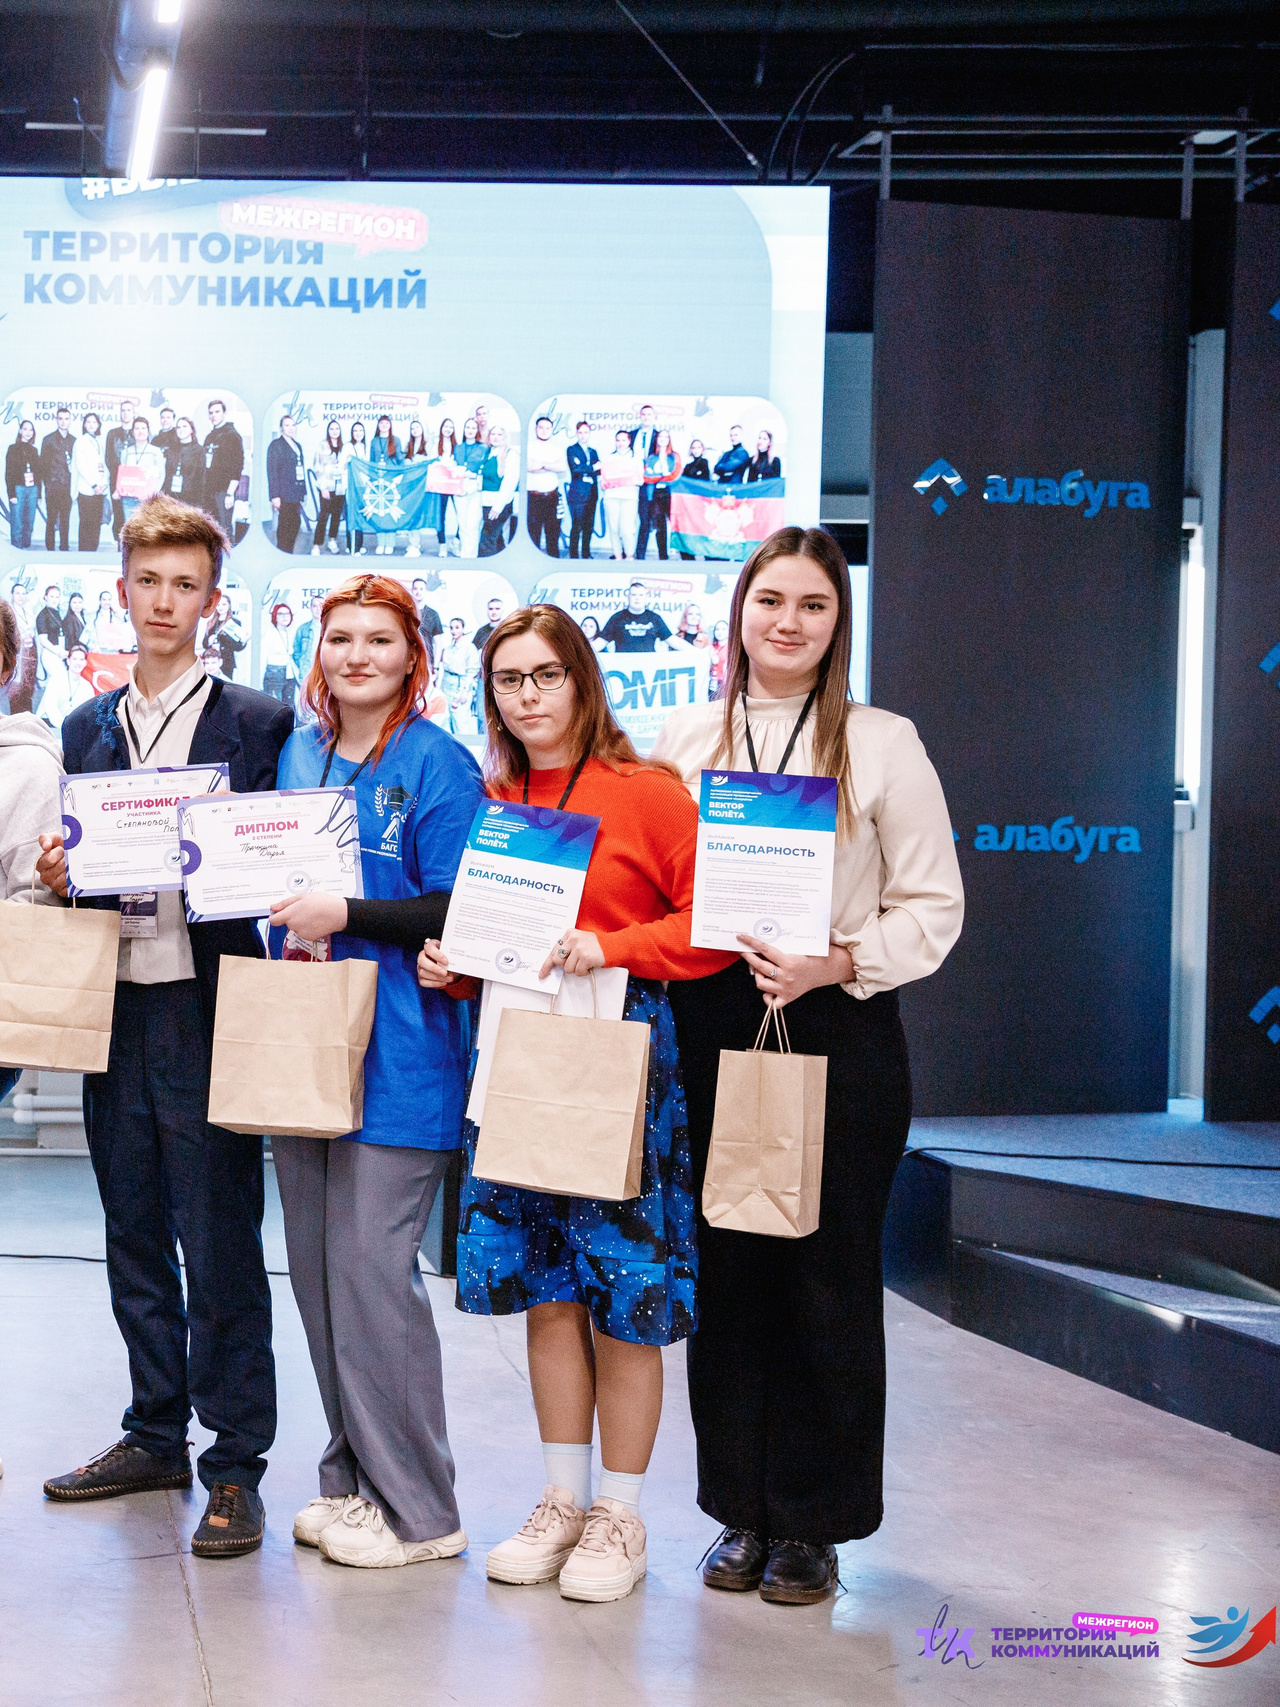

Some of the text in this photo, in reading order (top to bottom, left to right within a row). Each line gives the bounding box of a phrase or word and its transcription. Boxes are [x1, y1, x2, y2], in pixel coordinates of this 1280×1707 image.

[231, 202, 417, 241] МЕЖРЕГИОН
[24, 230, 324, 265] ТЕРРИТОРИЯ
[23, 270, 427, 314] КОММУНИКАЦИЙ
[984, 469, 1151, 518] алабуга
[101, 796, 190, 812] СЕРТИФИКА
[709, 801, 745, 809] ВЕКТОР
[234, 820, 299, 836] ДИПЛОМ
[479, 829, 510, 840] ВЕКТОР
[381, 842, 398, 852] БАГС
[707, 842, 816, 858] БЛАГОДАРНОСТЬ
[974, 816, 1141, 863] алабуга
[467, 868, 565, 895] БЛАГОДАРНОСТЬ
